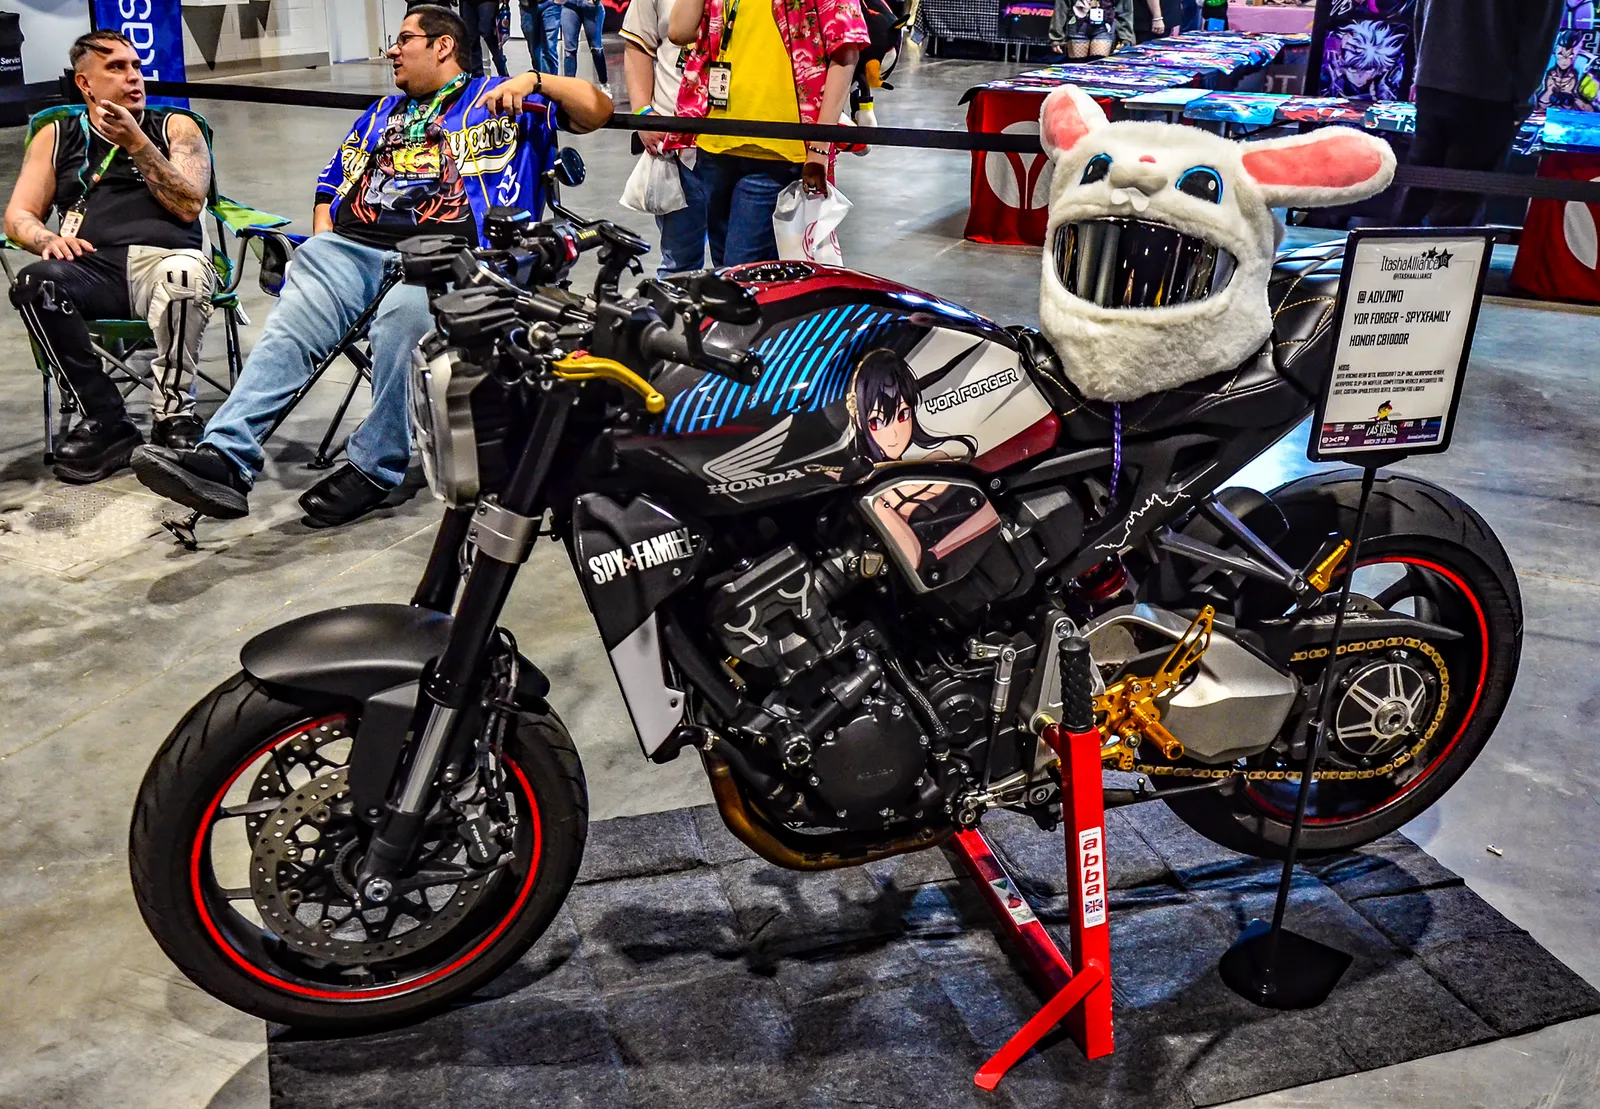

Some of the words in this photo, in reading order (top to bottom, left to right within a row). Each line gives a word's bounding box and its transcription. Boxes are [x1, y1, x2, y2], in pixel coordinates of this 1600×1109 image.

[1354, 313, 1369, 324] YOR
[1370, 312, 1399, 324] FORGER
[1405, 310, 1451, 323] SPYXFAMILY
[1349, 334, 1375, 346] HONDA
[1376, 333, 1410, 345] CB1000R
[924, 390, 961, 415] YOR
[959, 367, 1019, 403] FORGER
[1366, 424, 1379, 437] LAS
[1379, 423, 1398, 435] VEGAS
[707, 468, 805, 495] HONDA
[471, 823, 488, 858] TOKICO
[1083, 838, 1101, 897] abba
